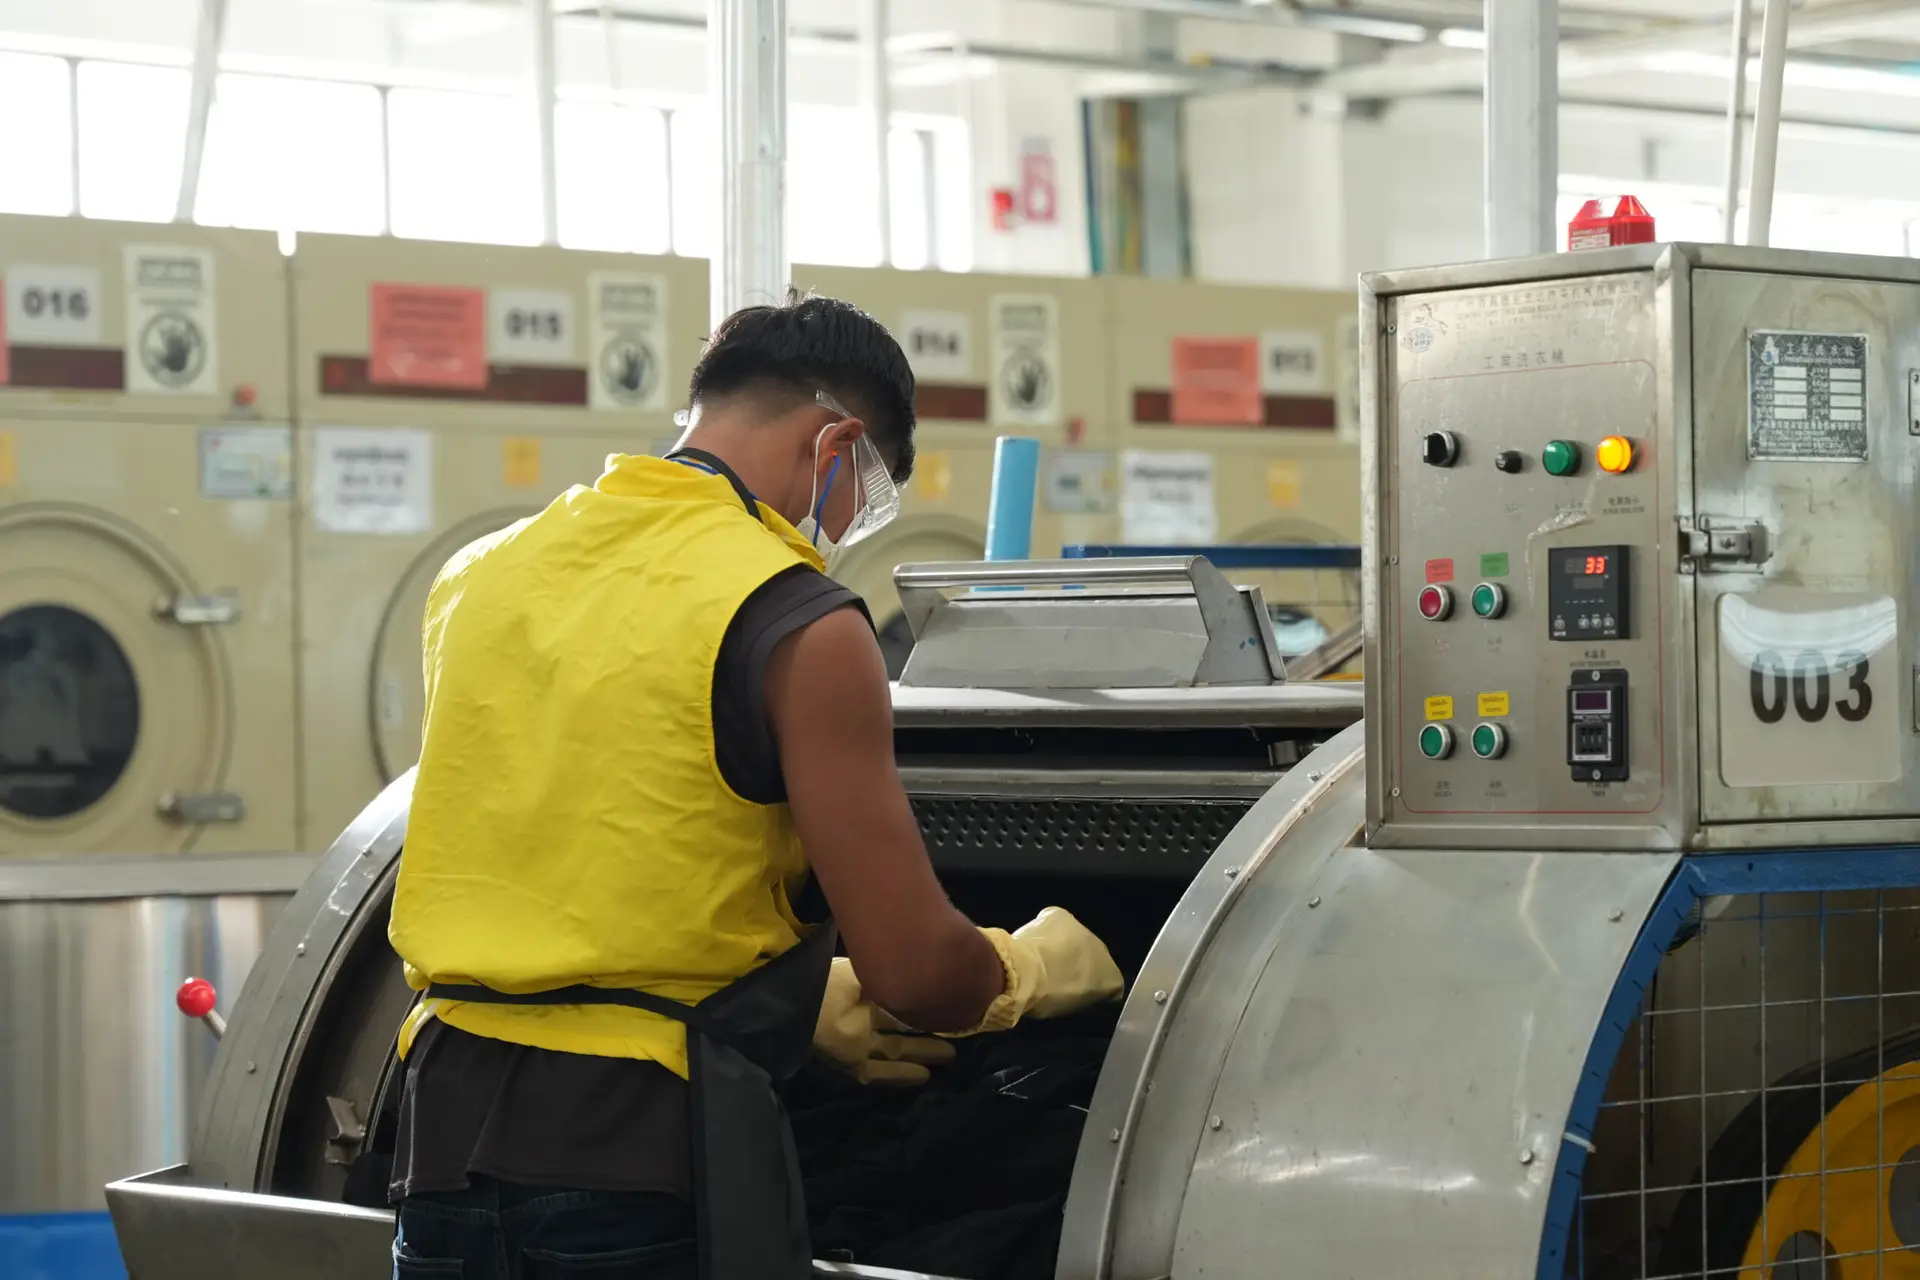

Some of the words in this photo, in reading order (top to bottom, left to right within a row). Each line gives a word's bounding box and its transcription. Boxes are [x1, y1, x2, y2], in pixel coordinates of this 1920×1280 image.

[22, 286, 90, 320] 016
[1584, 555, 1606, 575] 33
[1750, 649, 1873, 724] 003
